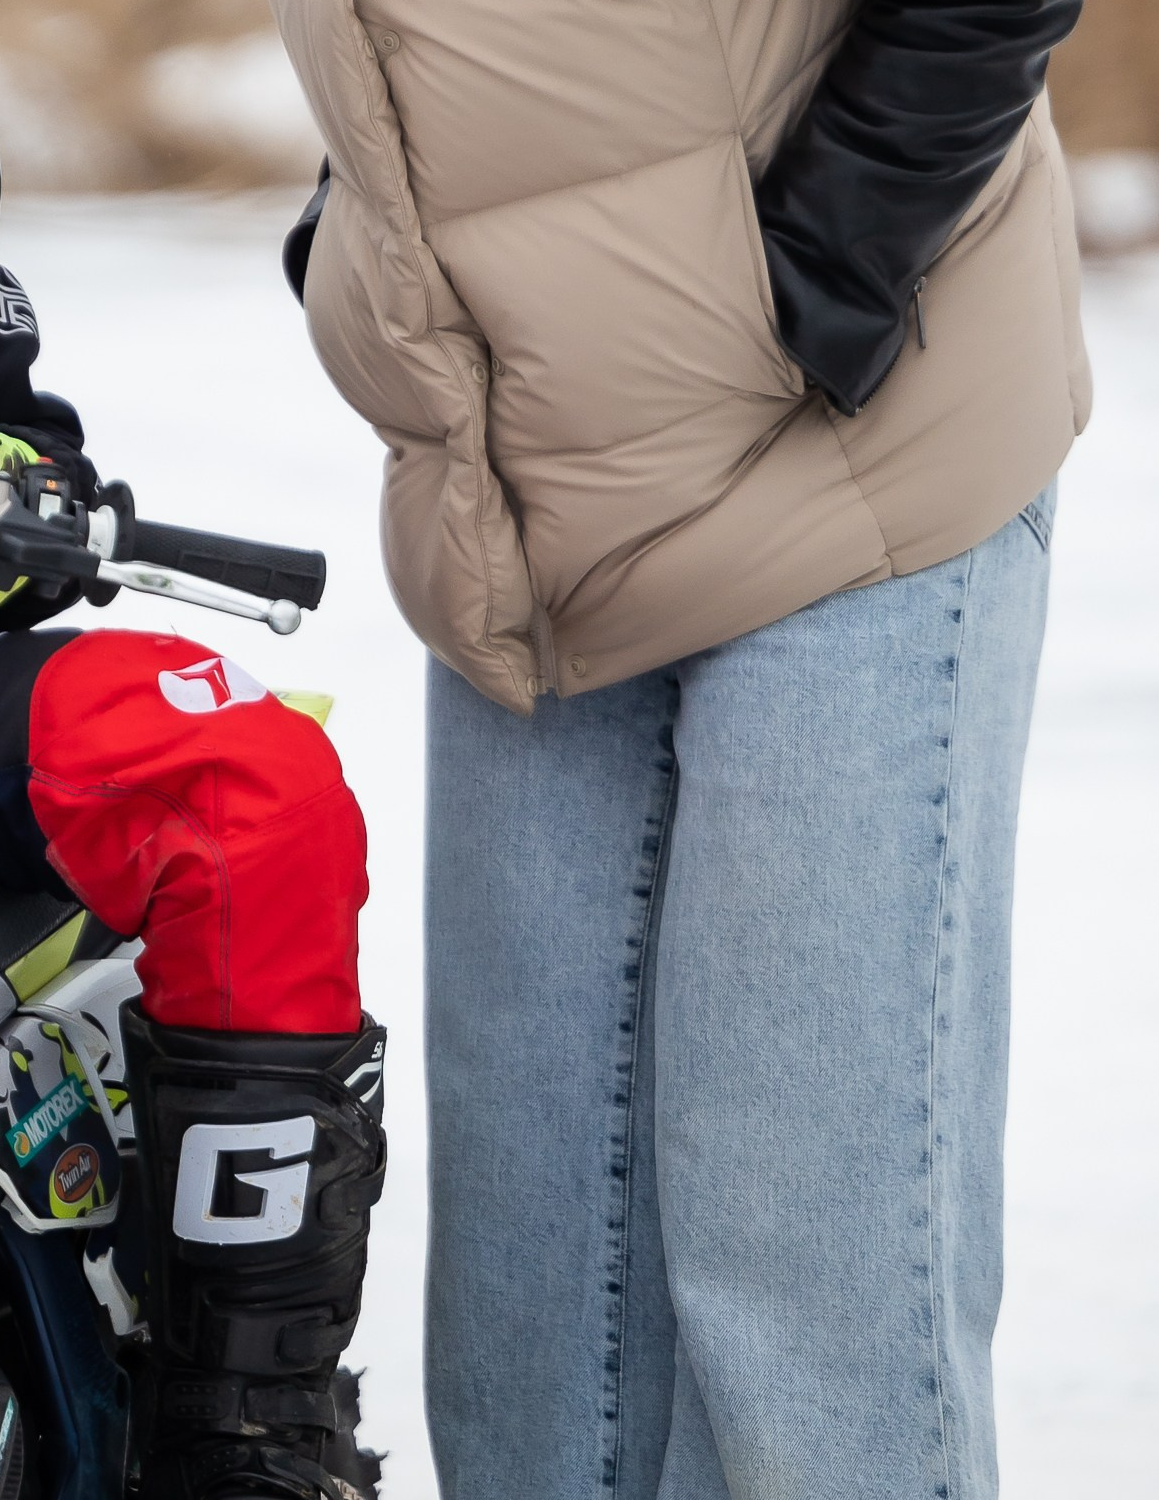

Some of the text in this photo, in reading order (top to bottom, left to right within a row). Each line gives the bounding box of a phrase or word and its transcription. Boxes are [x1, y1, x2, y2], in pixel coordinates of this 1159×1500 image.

[22, 1080, 85, 1148] MOTOREX
[58, 1153, 92, 1193] Twin Air
